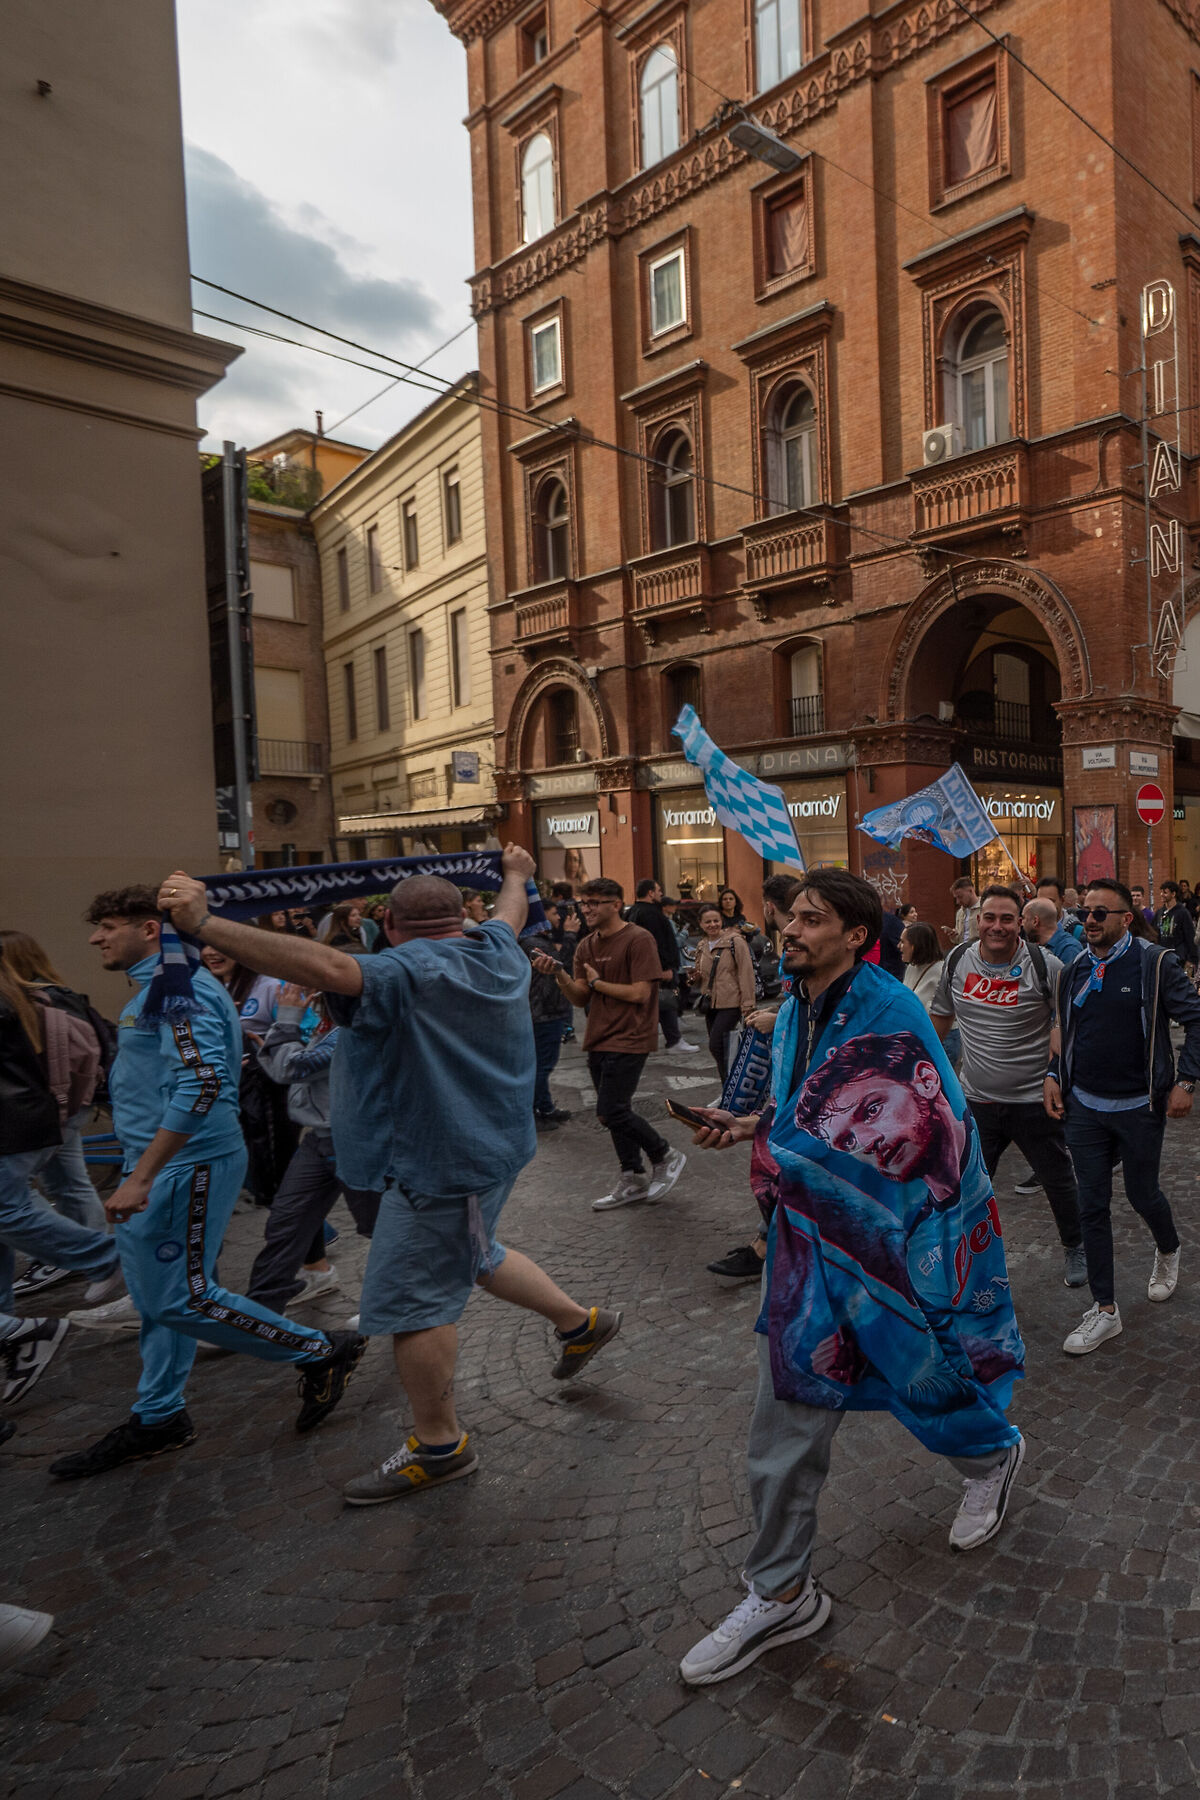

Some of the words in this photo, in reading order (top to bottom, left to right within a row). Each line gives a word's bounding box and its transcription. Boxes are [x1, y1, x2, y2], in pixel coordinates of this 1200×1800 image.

[1142, 279, 1182, 655] DIANA
[764, 747, 838, 770] DIANA
[963, 977, 1017, 1004] Lete
[732, 1039, 772, 1116] APOLI
